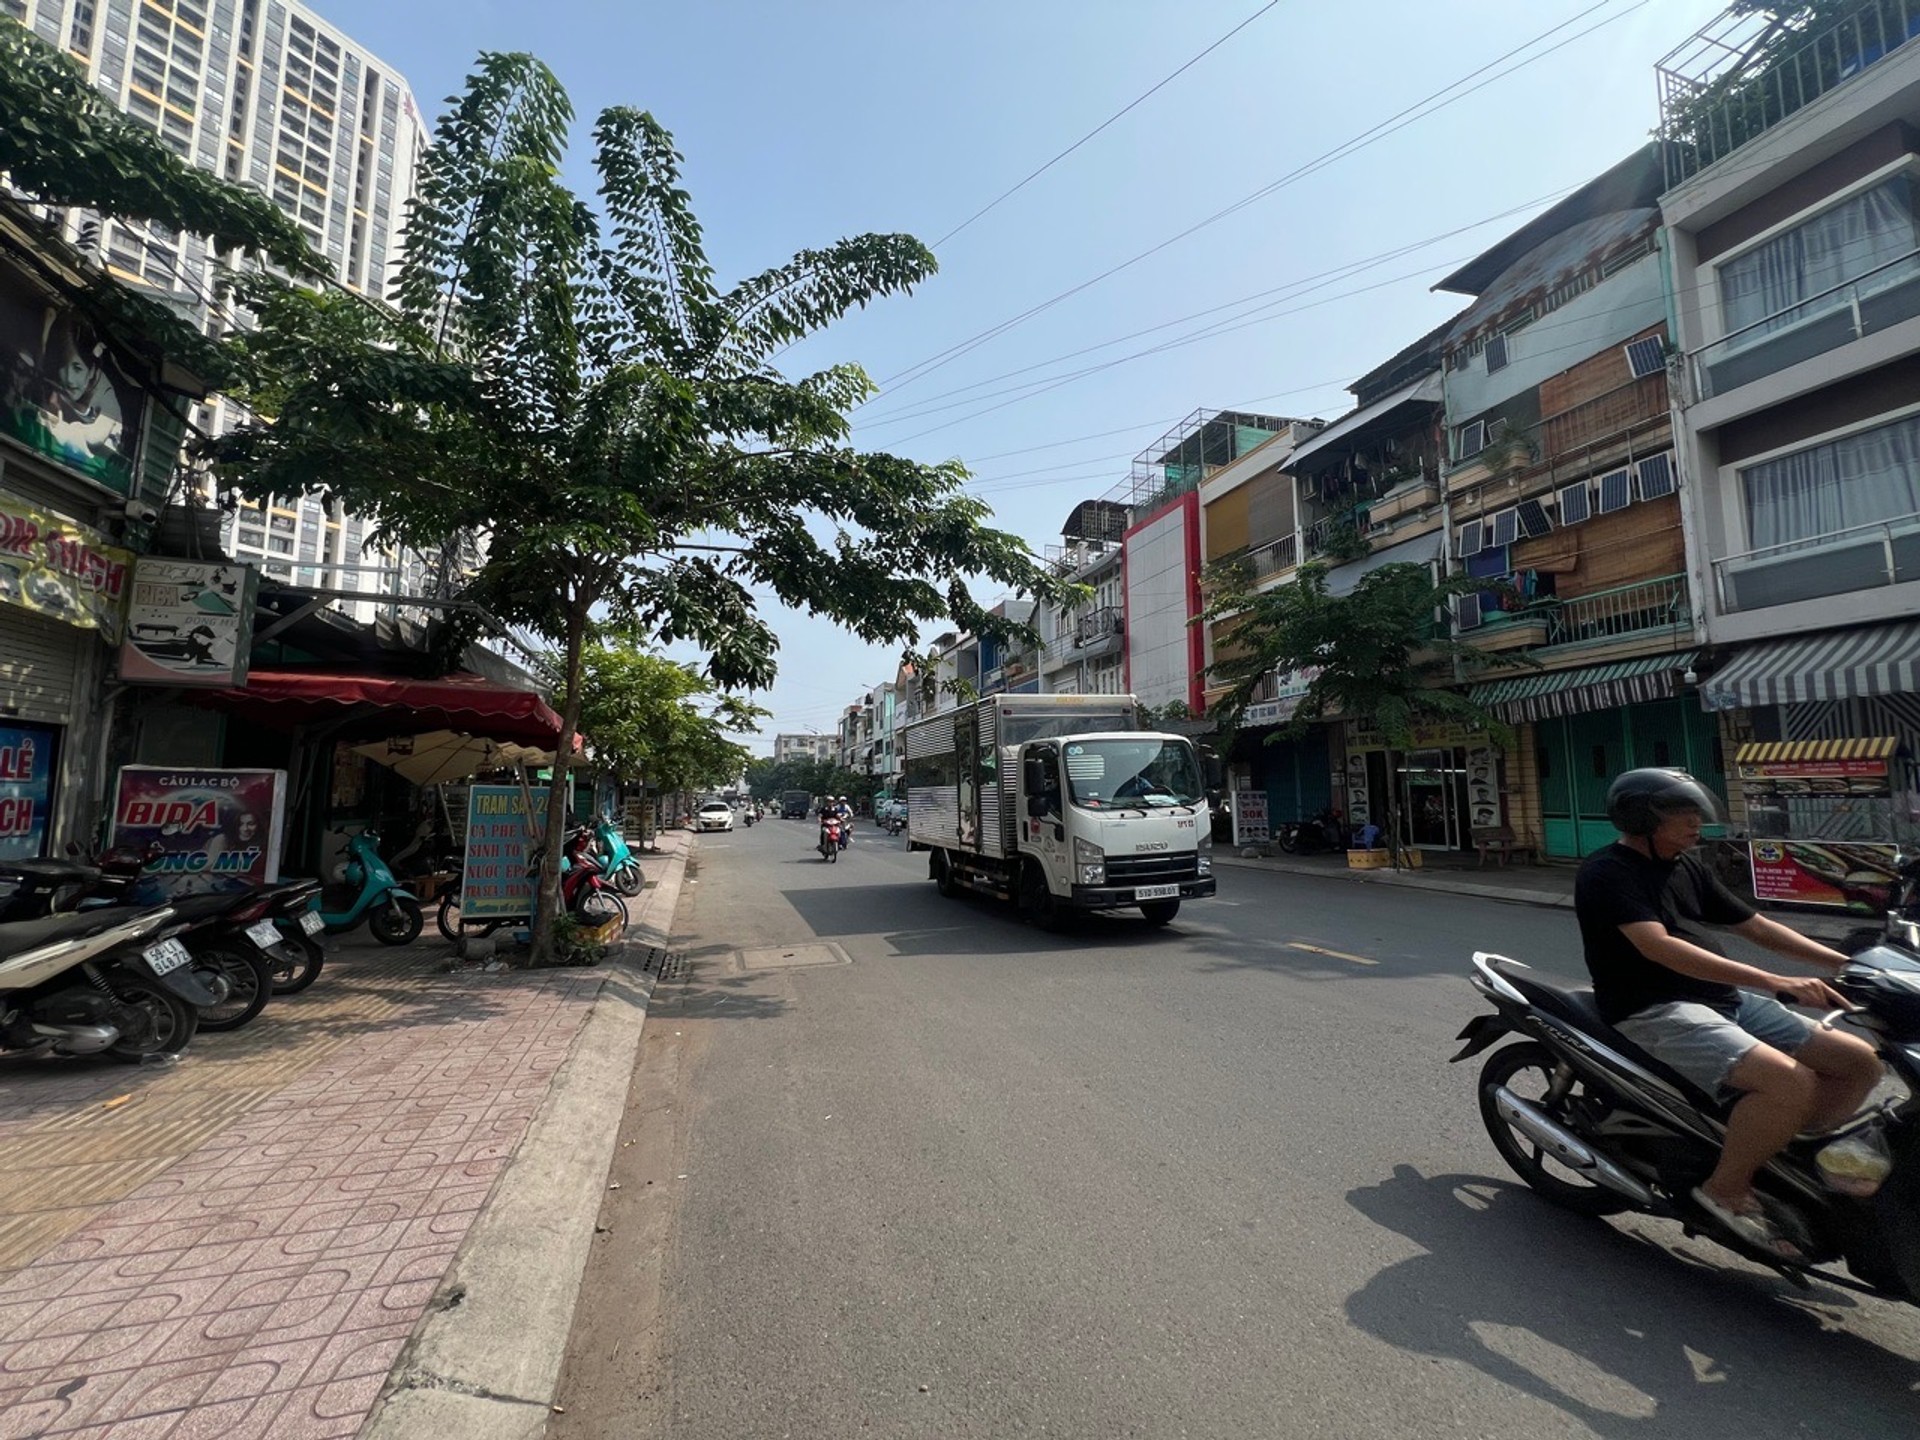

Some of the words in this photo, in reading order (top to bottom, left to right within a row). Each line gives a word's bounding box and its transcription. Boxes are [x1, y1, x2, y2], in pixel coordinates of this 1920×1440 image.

[124, 799, 219, 834] BIDA
[210, 846, 261, 873] MỸ
[1136, 842, 1168, 852] ISUZU
